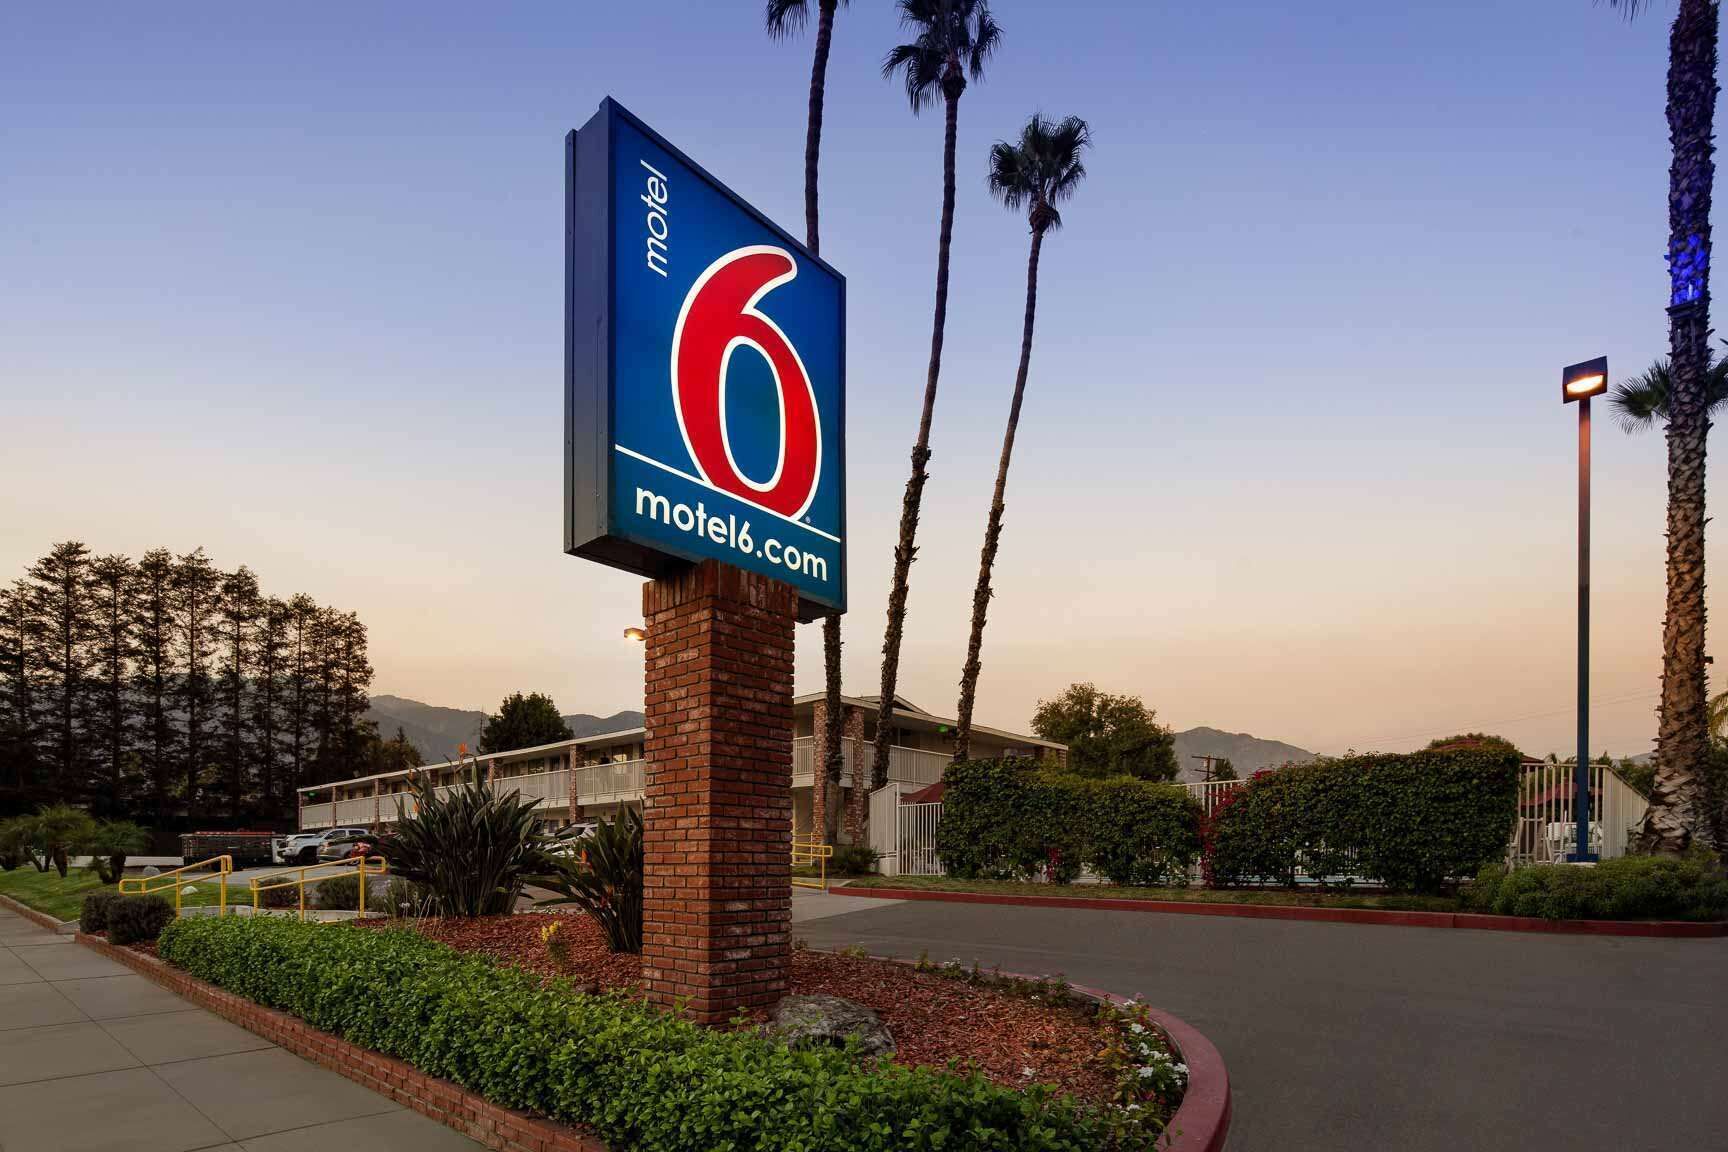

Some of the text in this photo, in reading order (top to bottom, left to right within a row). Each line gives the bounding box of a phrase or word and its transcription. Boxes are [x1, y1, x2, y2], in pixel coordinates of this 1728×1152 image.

[640, 159, 668, 278] motel
[671, 244, 822, 522] 6
[636, 487, 828, 582] motel6.com
